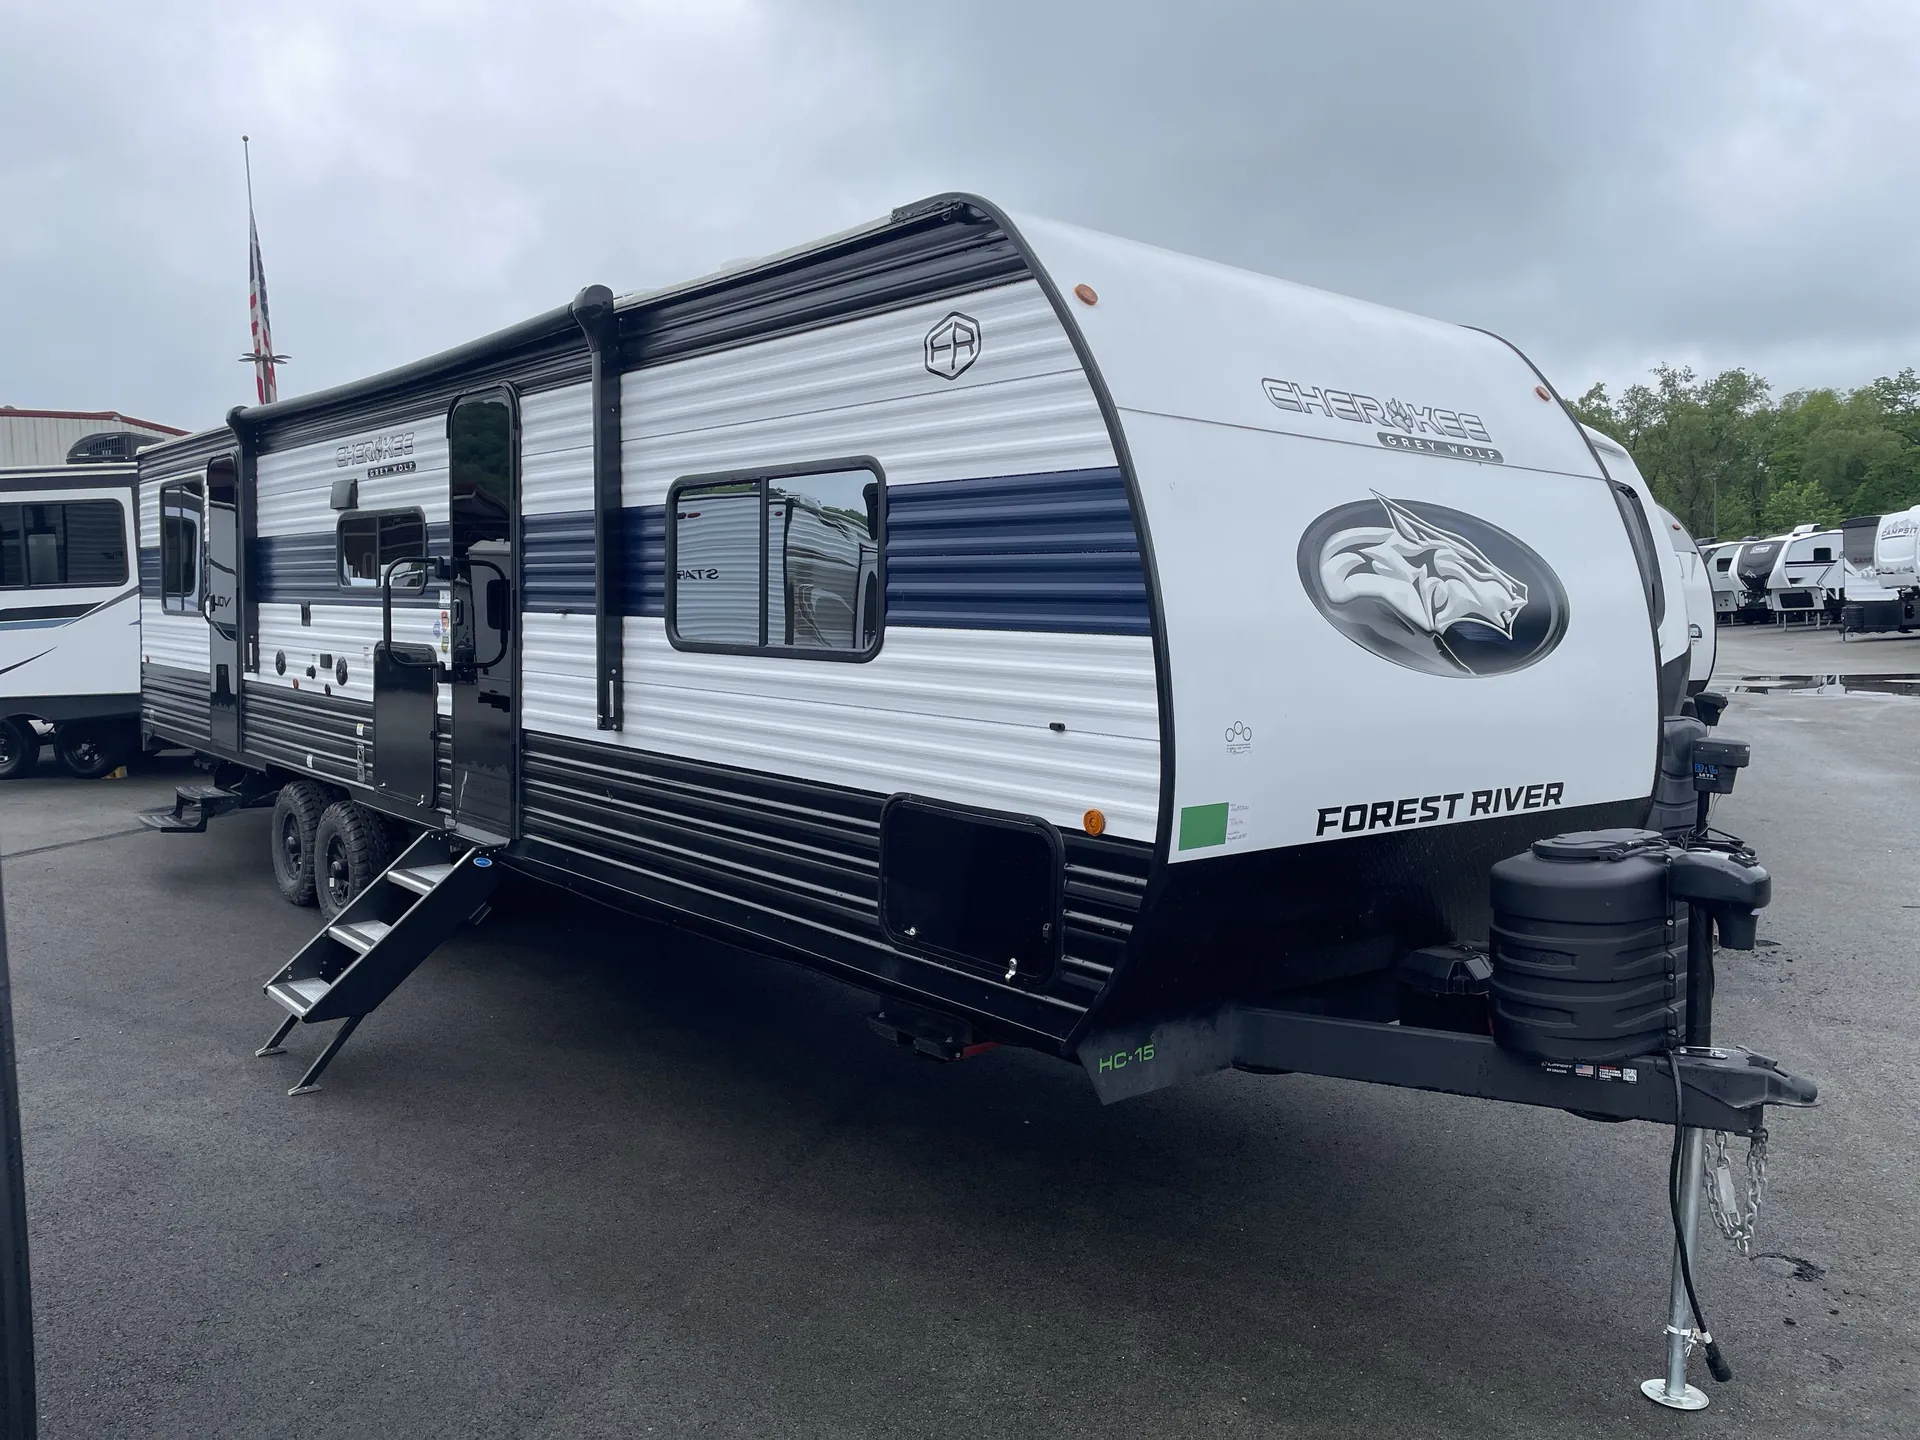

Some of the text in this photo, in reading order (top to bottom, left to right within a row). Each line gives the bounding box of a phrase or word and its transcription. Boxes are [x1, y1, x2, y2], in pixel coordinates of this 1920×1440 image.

[1261, 377, 1492, 443] CHEROKEE
[336, 432, 414, 468] CHEROKEE
[1386, 435, 1496, 460] GREY WOLF
[369, 462, 413, 478] GREY WOLF
[1316, 782, 1565, 836] FOREST RIVER
